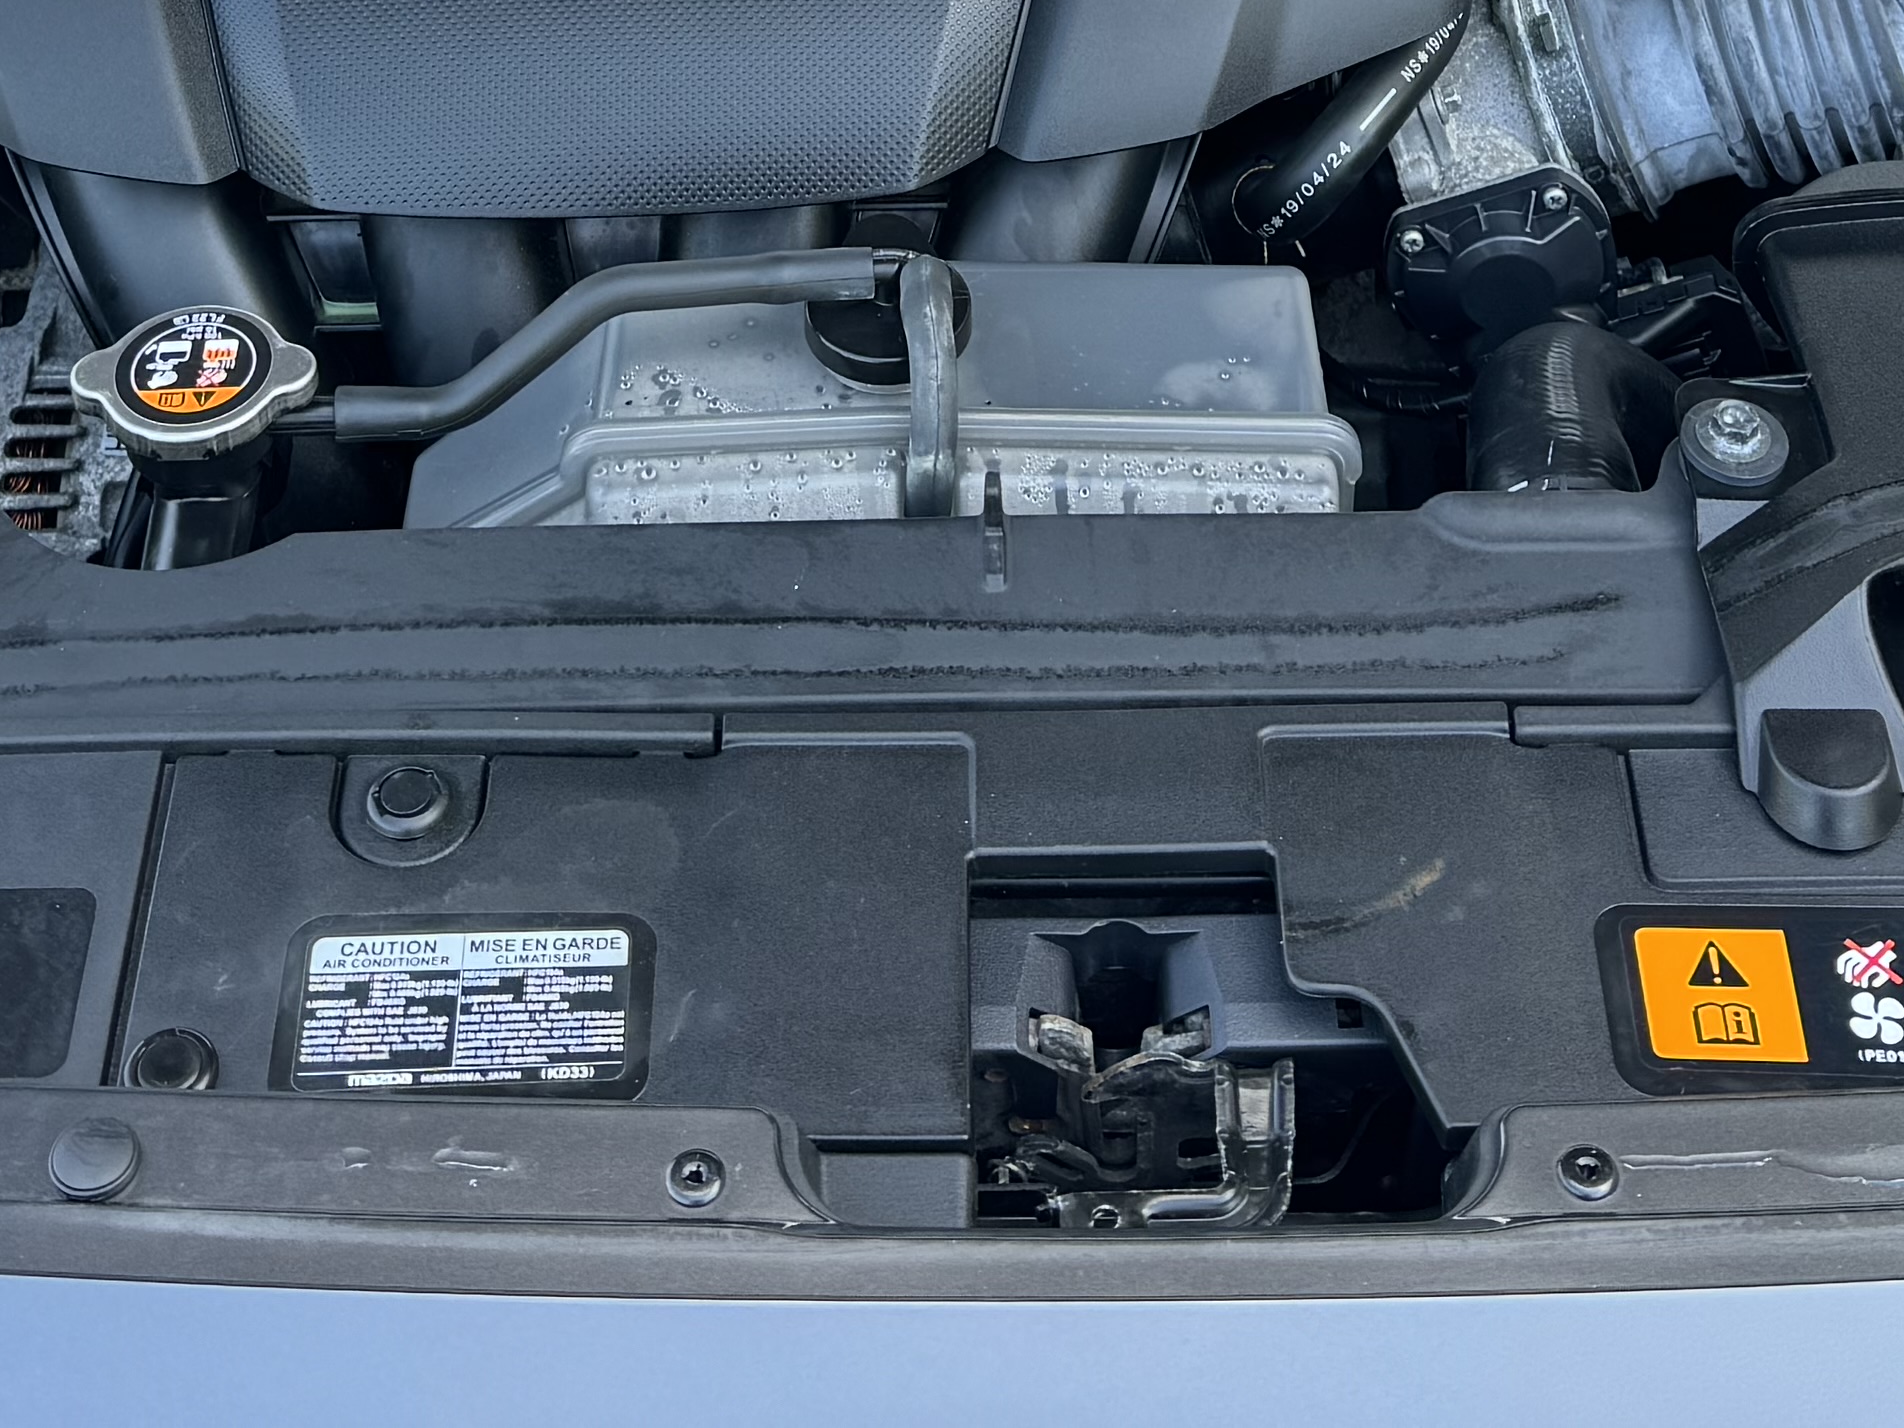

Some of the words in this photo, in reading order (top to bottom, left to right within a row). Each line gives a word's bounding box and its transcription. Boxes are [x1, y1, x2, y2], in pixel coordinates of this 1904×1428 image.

[340, 939, 438, 957] CAUTION
[469, 938, 517, 953] MISE
[522, 937, 548, 952] EN
[552, 936, 623, 951] GARDE
[322, 958, 347, 969] AIR
[351, 955, 450, 969] CONDITIONER
[494, 952, 591, 965] CLIMATISEUR
[485, 1070, 522, 1081] JAPAN
[540, 1066, 596, 1080] (KD33)
